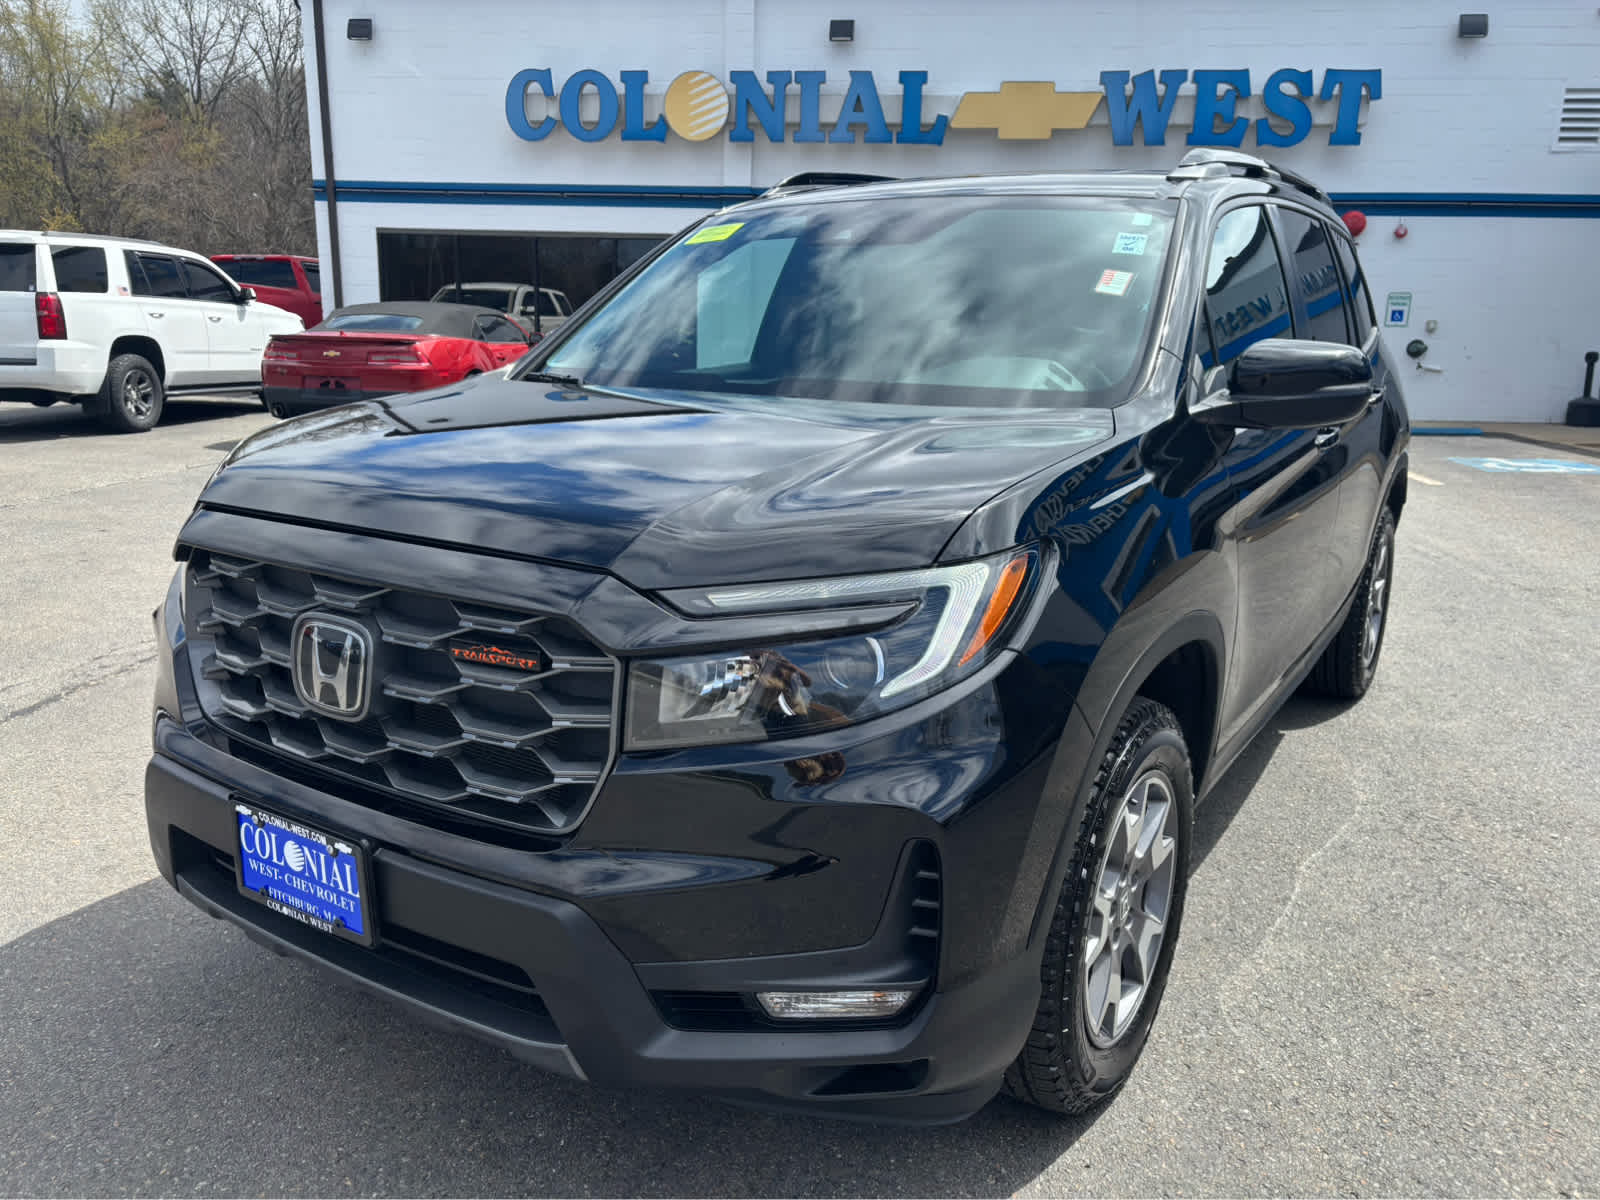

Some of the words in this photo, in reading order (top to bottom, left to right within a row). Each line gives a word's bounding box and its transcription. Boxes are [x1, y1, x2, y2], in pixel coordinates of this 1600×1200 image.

[505, 68, 949, 146] COLONIAL
[1099, 68, 1382, 148] WEST
[451, 646, 537, 669] TRAILSPORT
[240, 822, 361, 898] COLONIAL
[284, 872, 356, 913] CHEVROLET
[309, 916, 335, 934] WEST
